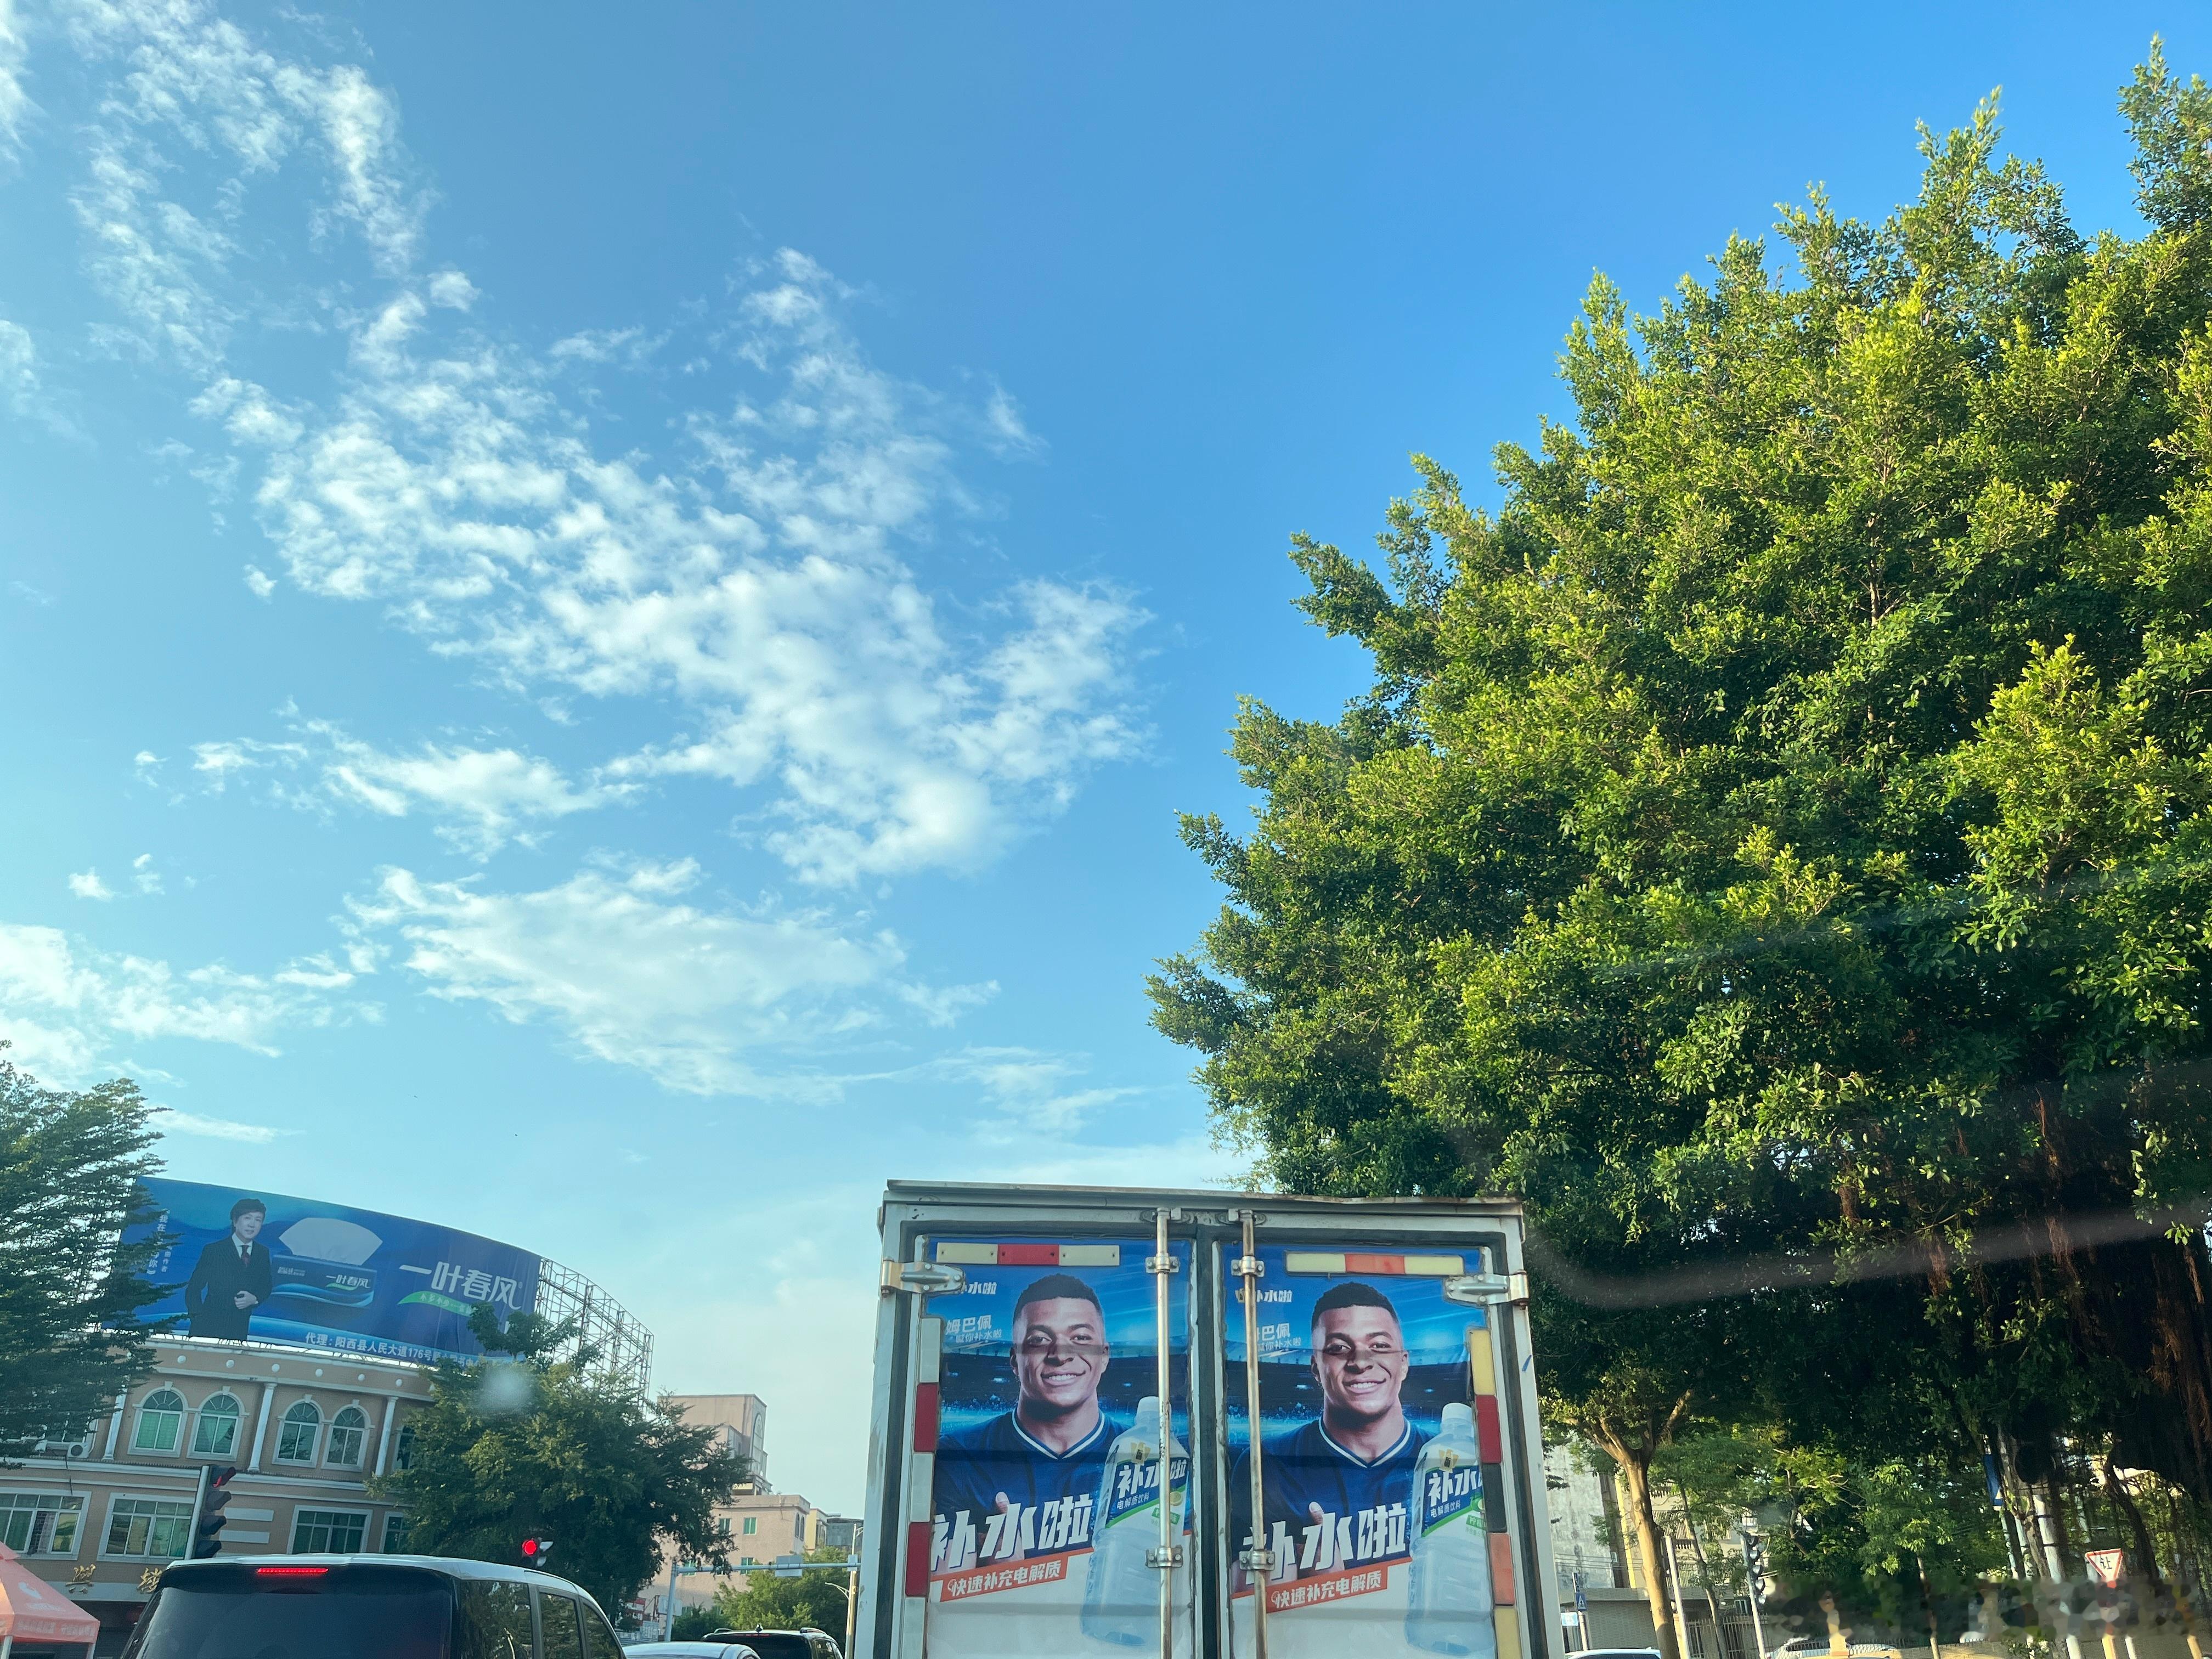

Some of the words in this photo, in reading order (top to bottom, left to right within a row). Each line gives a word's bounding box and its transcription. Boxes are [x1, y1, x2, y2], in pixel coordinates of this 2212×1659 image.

[326, 1274, 371, 1289] 一叶春风
[399, 1261, 522, 1310] 一叶春风
[946, 1314, 992, 1335] 姆巴佩
[1256, 1323, 1290, 1341] 巴佩
[956, 1328, 1002, 1343] 喊你补水啦
[1428, 1469, 1483, 1507] 补水
[1117, 1492, 1150, 1510] 电解质饮料
[1430, 1499, 1461, 1518] 电解质饮料
[930, 1493, 1093, 1572] 补水啦
[2100, 1556, 2113, 1570] 让
[951, 1560, 1062, 1597] 快速补充电解质
[1276, 1570, 1381, 1609] 快速补充电解质
